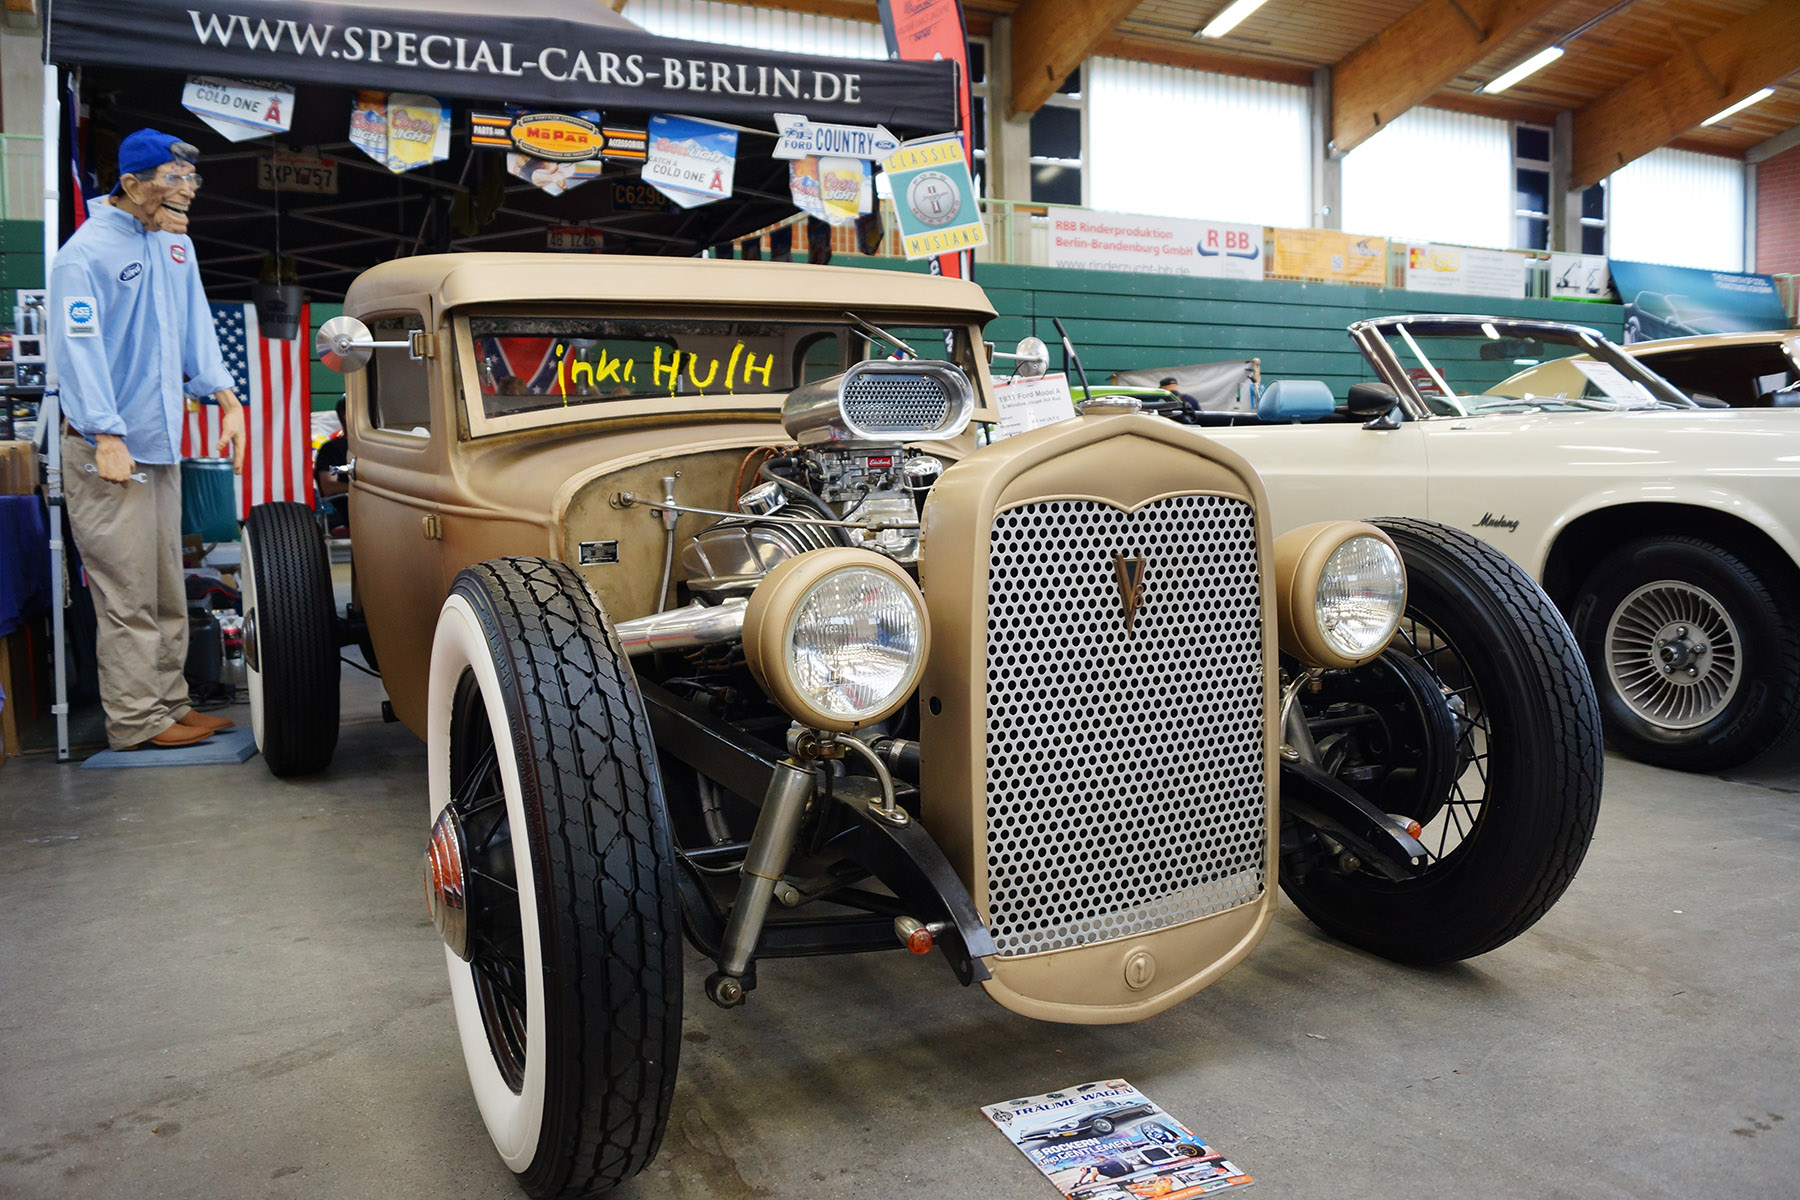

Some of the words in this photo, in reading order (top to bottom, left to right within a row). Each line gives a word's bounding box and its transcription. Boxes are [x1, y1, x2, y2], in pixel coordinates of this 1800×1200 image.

[187, 9, 862, 104] WWW.SPECIAL-CARS-BERLIN.DE
[196, 87, 231, 105] COLD
[233, 97, 261, 113] ONE
[391, 128, 433, 145] LIGHT
[473, 125, 494, 136] PARTS
[494, 128, 506, 136] AND
[608, 138, 645, 150] ACCESSORIES
[656, 137, 689, 157] Coors
[687, 149, 722, 163] LIGHT
[784, 140, 812, 150] FORD
[816, 128, 875, 155] COUNTRY
[648, 155, 671, 166] CATCH
[888, 145, 957, 169] CLASSIC
[653, 164, 681, 178] COLD
[683, 170, 706, 183] ONE
[824, 189, 857, 203] LIGHT
[1055, 220, 1077, 231] RBB
[1079, 221, 1174, 239] Rinderproduktion
[911, 227, 980, 254] MUSTANG
[1055, 237, 1160, 256] Berlin-Brandenburg
[1162, 245, 1194, 256] GmbH
[71, 306, 91, 316] ASE
[1017, 392, 1034, 400] Ford
[1035, 389, 1055, 397] Model
[1472, 512, 1520, 533] Mustang
[1012, 1097, 1078, 1116] TRÄUME
[1080, 1087, 1134, 1101] WAGEN
[1039, 1155, 1059, 1166] UND
[1057, 1138, 1133, 1160] GENTLEMEN
[1041, 1137, 1101, 1155] ROCKERN
